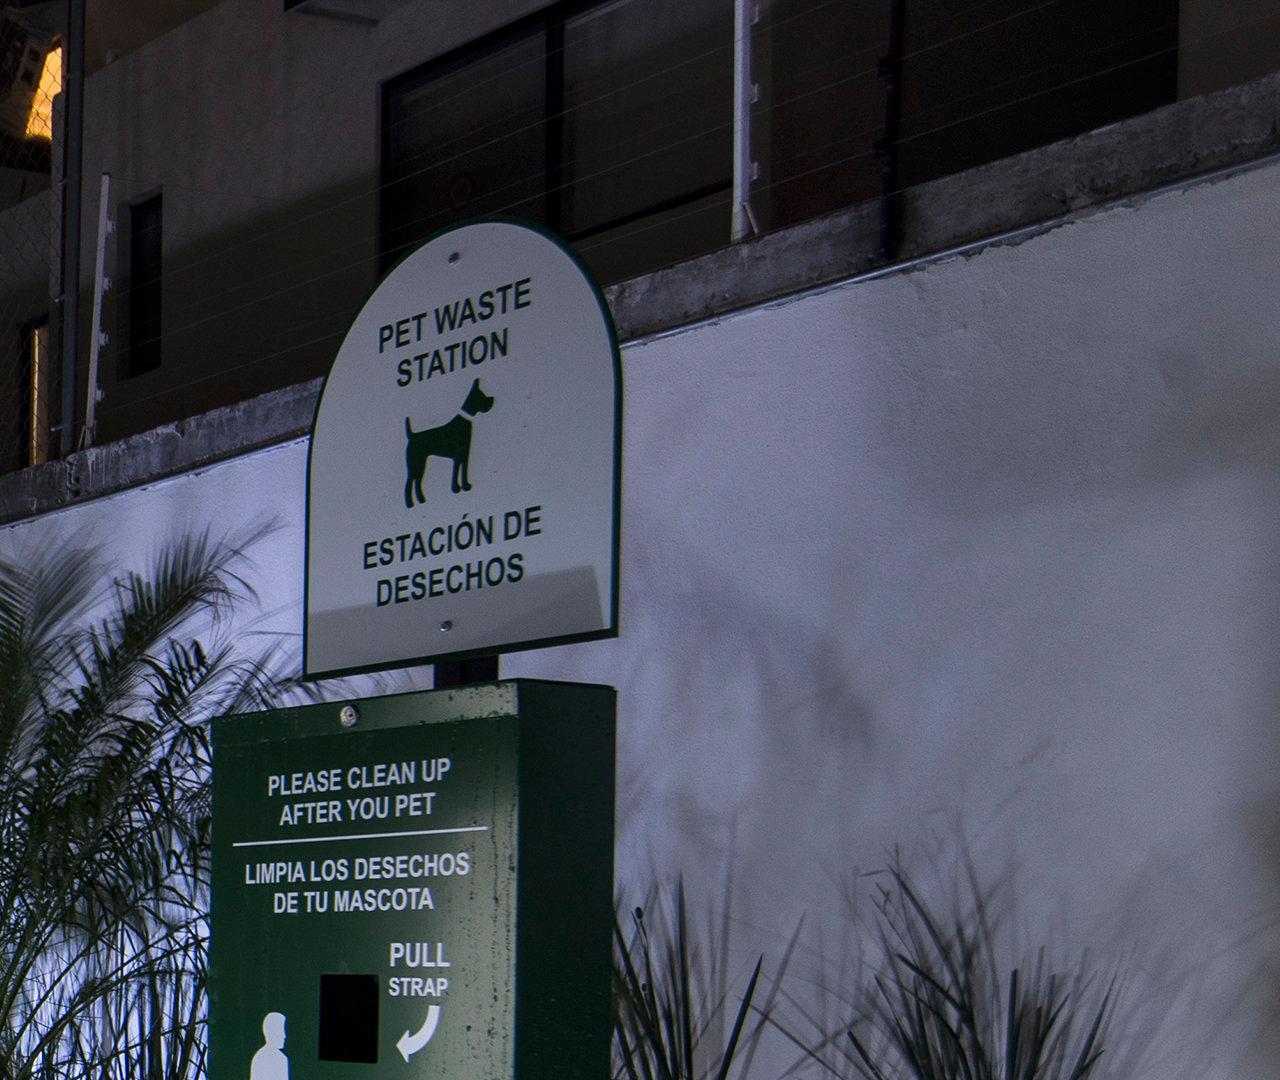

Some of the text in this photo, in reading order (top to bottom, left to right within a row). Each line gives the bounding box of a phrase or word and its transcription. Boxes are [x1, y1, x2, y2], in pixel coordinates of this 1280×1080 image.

[378, 276, 532, 354] PET WASTE
[396, 328, 508, 388] STATION
[362, 505, 543, 570] ESTACIÓN DE
[376, 552, 525, 608] DESECHOS
[268, 757, 452, 796] PLEASE CLEAN UP
[279, 792, 436, 826] AFTER YOU PET
[245, 851, 471, 885] LIMPIA LOS DESECHOS
[273, 887, 435, 915] DE TU MASCOTA
[389, 942, 451, 968] PULL
[388, 977, 449, 998] STRAP
